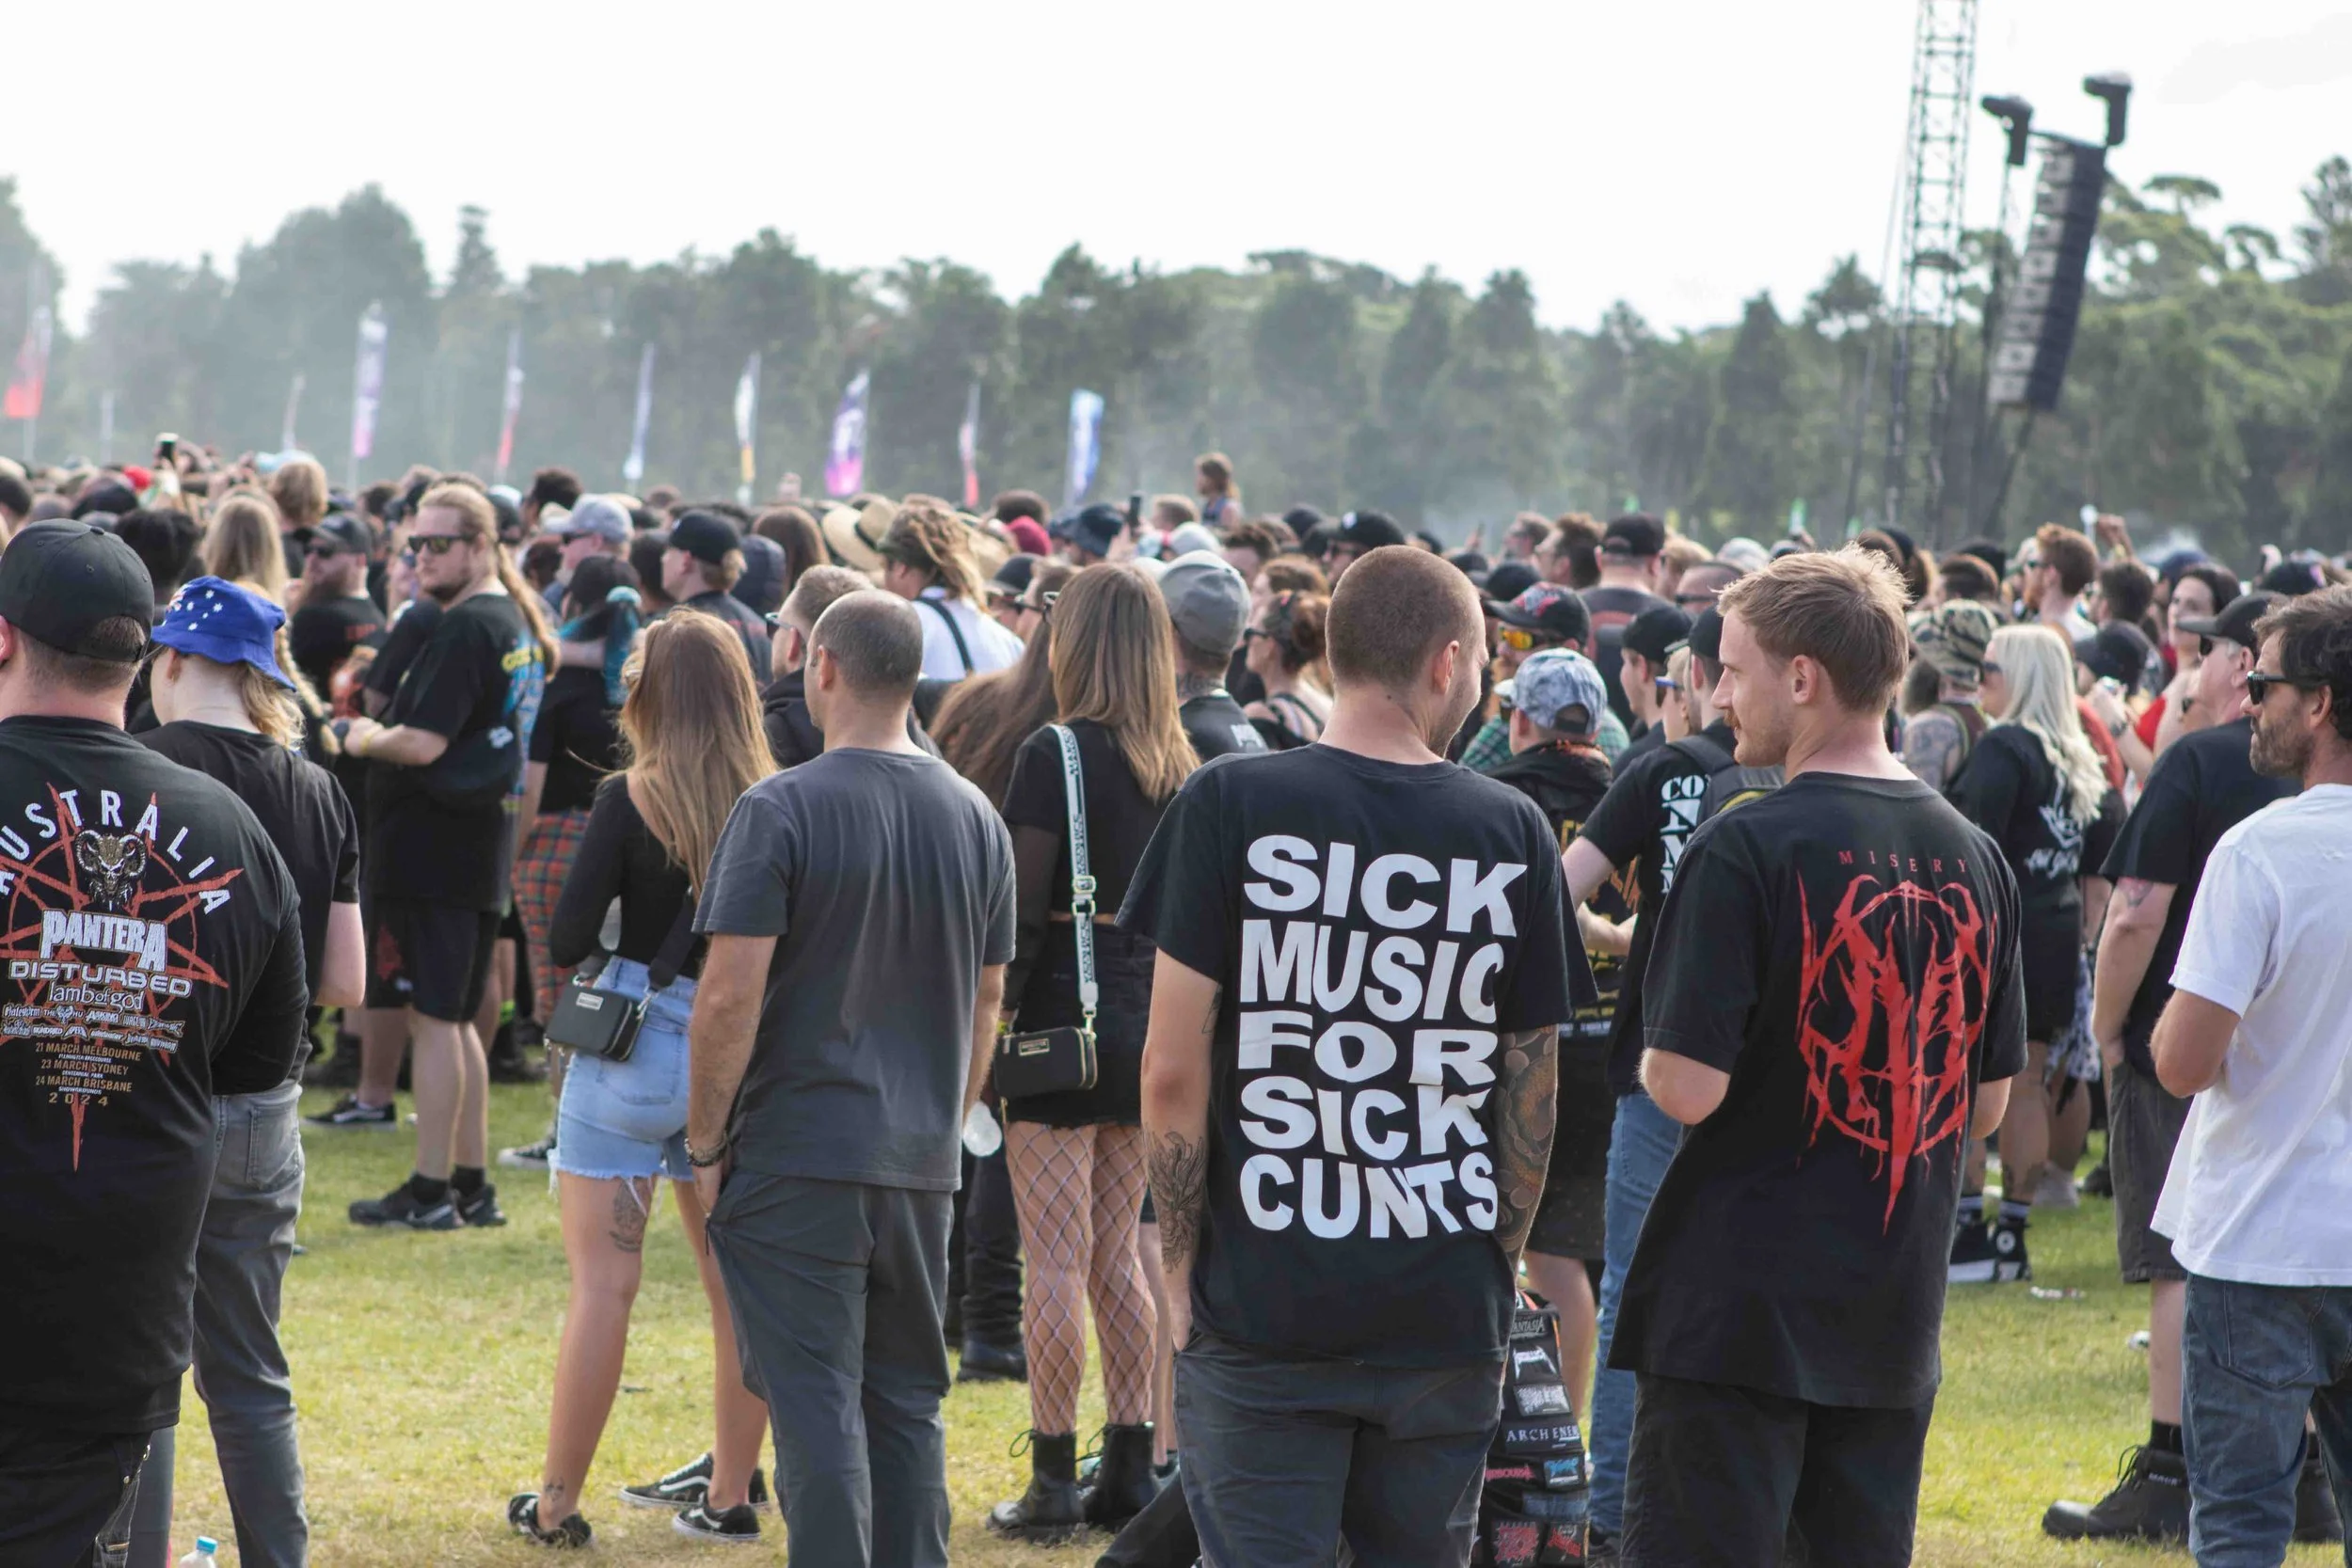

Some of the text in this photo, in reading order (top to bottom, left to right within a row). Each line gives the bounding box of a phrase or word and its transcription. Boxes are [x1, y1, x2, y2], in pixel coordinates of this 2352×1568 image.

[1838, 850, 1967, 873] MISERY
[1244, 834, 1528, 938] SICK
[40, 909, 167, 973] PANTERA
[9, 960, 192, 997] DISTURBED
[1239, 919, 1504, 1023] MUSIC
[49, 981, 145, 1013] lamb of god
[36, 1042, 142, 1061] 21 MARCH MELBOURNE
[1237, 1010, 1499, 1085] FOR
[36, 1076, 133, 1091] 24 MARCH BRISBANE
[41, 1059, 129, 1075] 23 MARCH SYDNEY
[49, 1092, 108, 1106] 2024
[1239, 1075, 1492, 1161] SICK
[1239, 1152, 1498, 1239] CUNTS
[1506, 1428, 1549, 1442] ARCH
